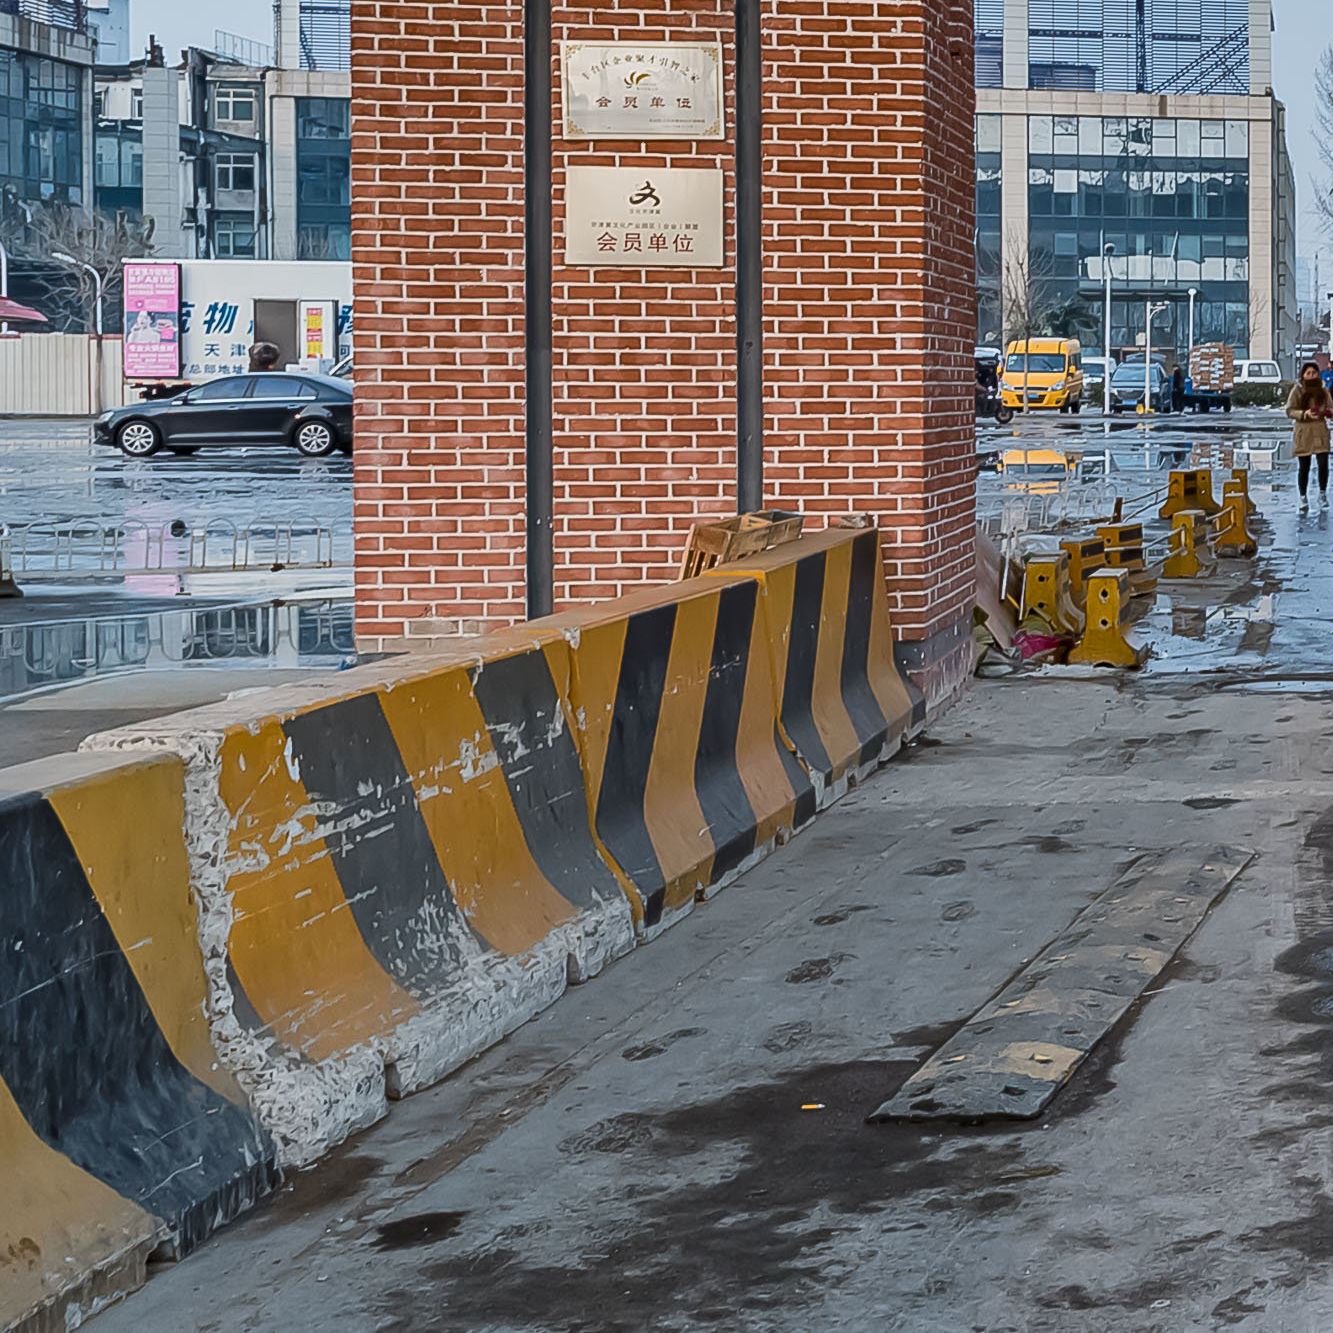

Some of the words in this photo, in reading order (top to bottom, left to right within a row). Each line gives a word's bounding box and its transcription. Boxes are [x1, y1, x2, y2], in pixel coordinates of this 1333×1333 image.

[596, 96, 692, 109] 会员单位
[597, 232, 694, 253] 会员单位
